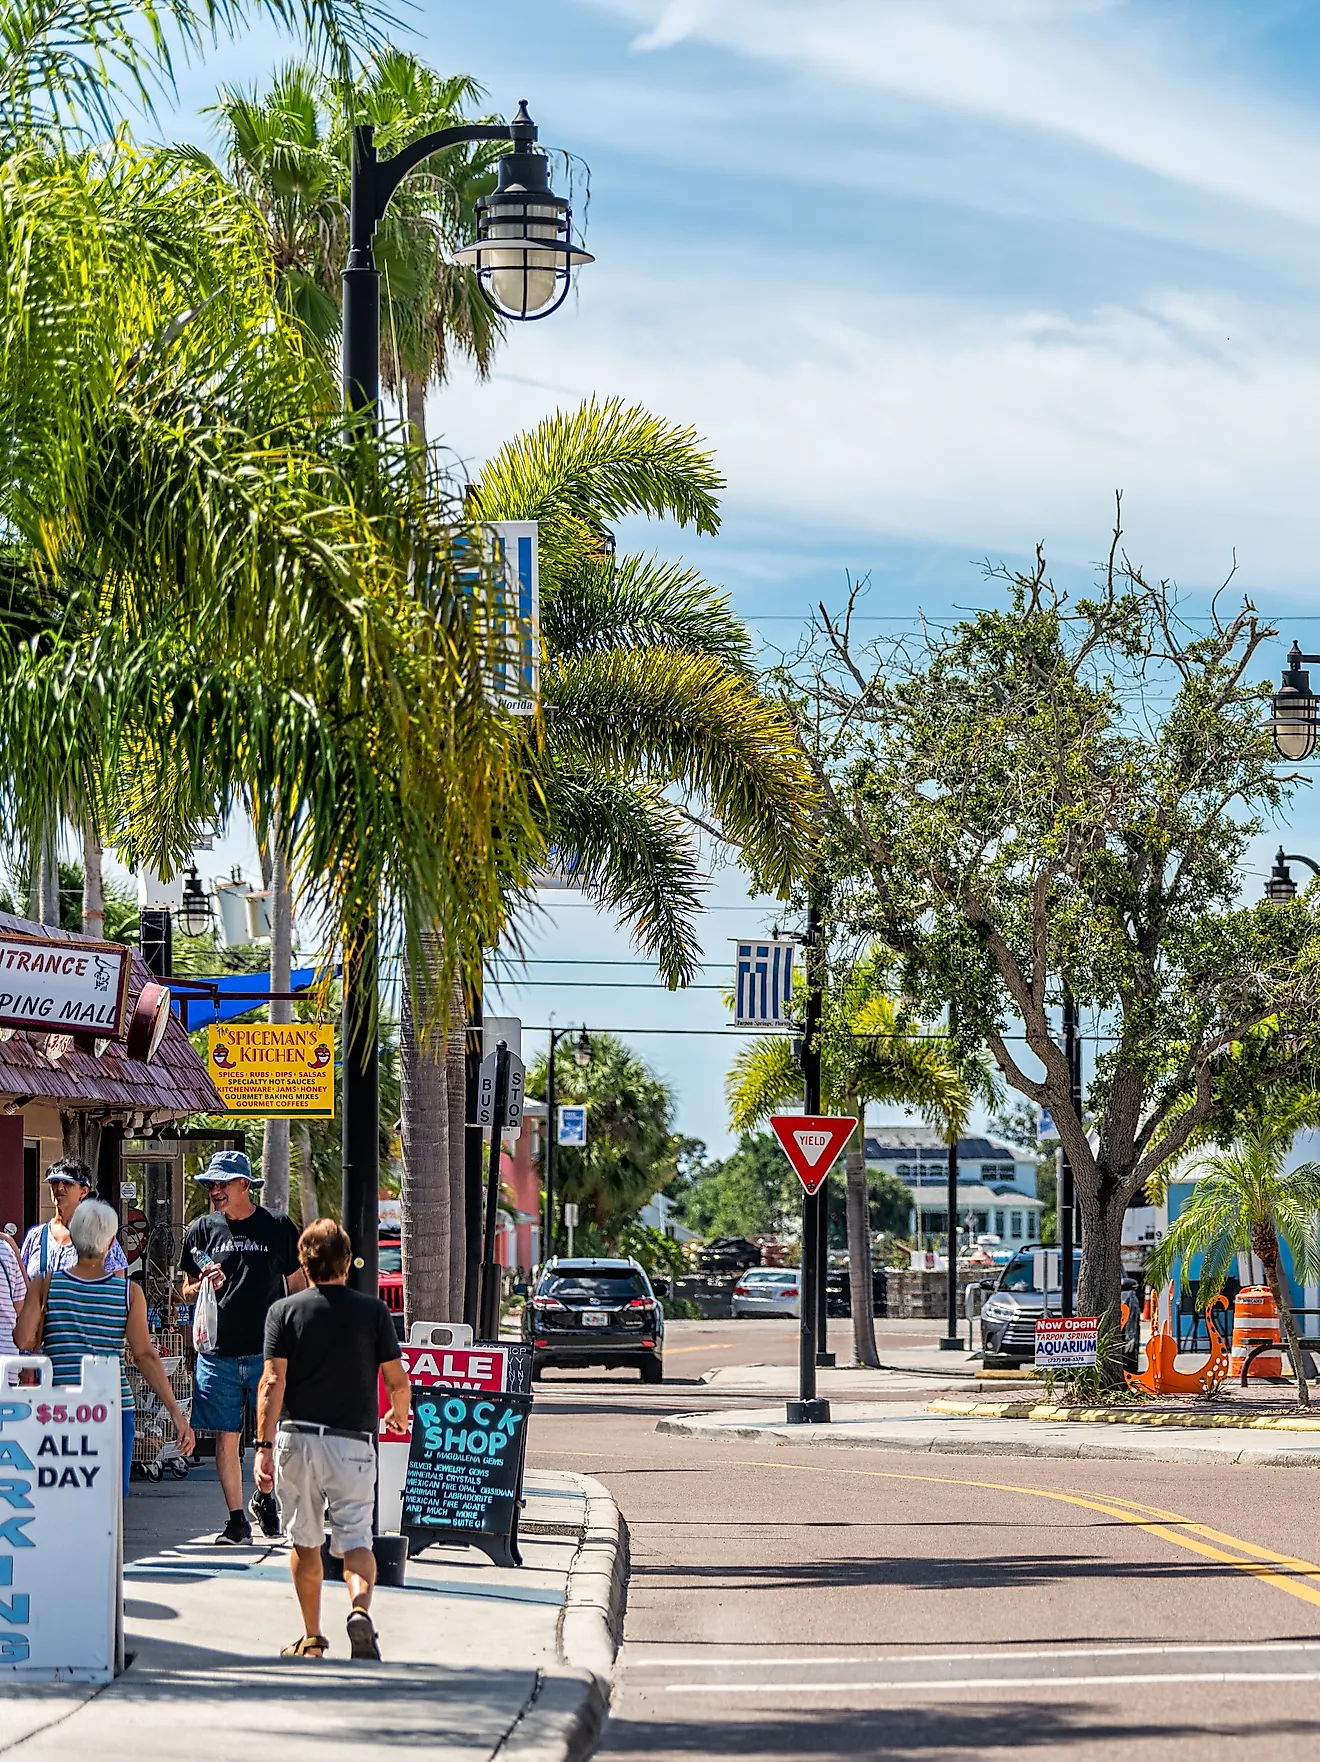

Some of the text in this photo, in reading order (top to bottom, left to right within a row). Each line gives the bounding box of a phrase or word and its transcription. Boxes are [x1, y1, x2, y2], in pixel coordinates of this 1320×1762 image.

[0, 949, 89, 976] TRANCE
[59, 1000, 116, 1025] MALL
[227, 1030, 317, 1045] SPICEMAN'S
[240, 1047, 305, 1062] KITCHEN
[480, 1078, 492, 1123] BUS
[508, 1072, 521, 1127] STOP
[799, 1135, 825, 1146] YIELD
[1037, 1319, 1097, 1330] Now Open!
[1037, 1332, 1097, 1341] TARPON SPRINGS
[1036, 1340, 1096, 1355] AQUARIUM
[401, 1352, 493, 1380] SALE
[36, 1403, 108, 1425] $5.00
[417, 1399, 523, 1436] ROCK
[37, 1435, 98, 1457] ALL
[424, 1426, 507, 1456] SHOP
[436, 1451, 481, 1464] MAGDALENA
[482, 1457, 504, 1466] GEMS
[38, 1466, 100, 1488] DAY
[407, 1470, 482, 1485] MINERALS CRYSTALS
[409, 1461, 490, 1478] SILVER JEWELRY GEMS
[405, 1487, 493, 1504] LARIMAR LABRADORITE
[407, 1478, 514, 1498] MEXICAN FIRE OPAL OBSIDIAN
[405, 1495, 486, 1512] MEXICAN FIRE AGATE
[406, 1504, 478, 1519] AND MUCH MORE
[452, 1518, 474, 1527] SUITE
